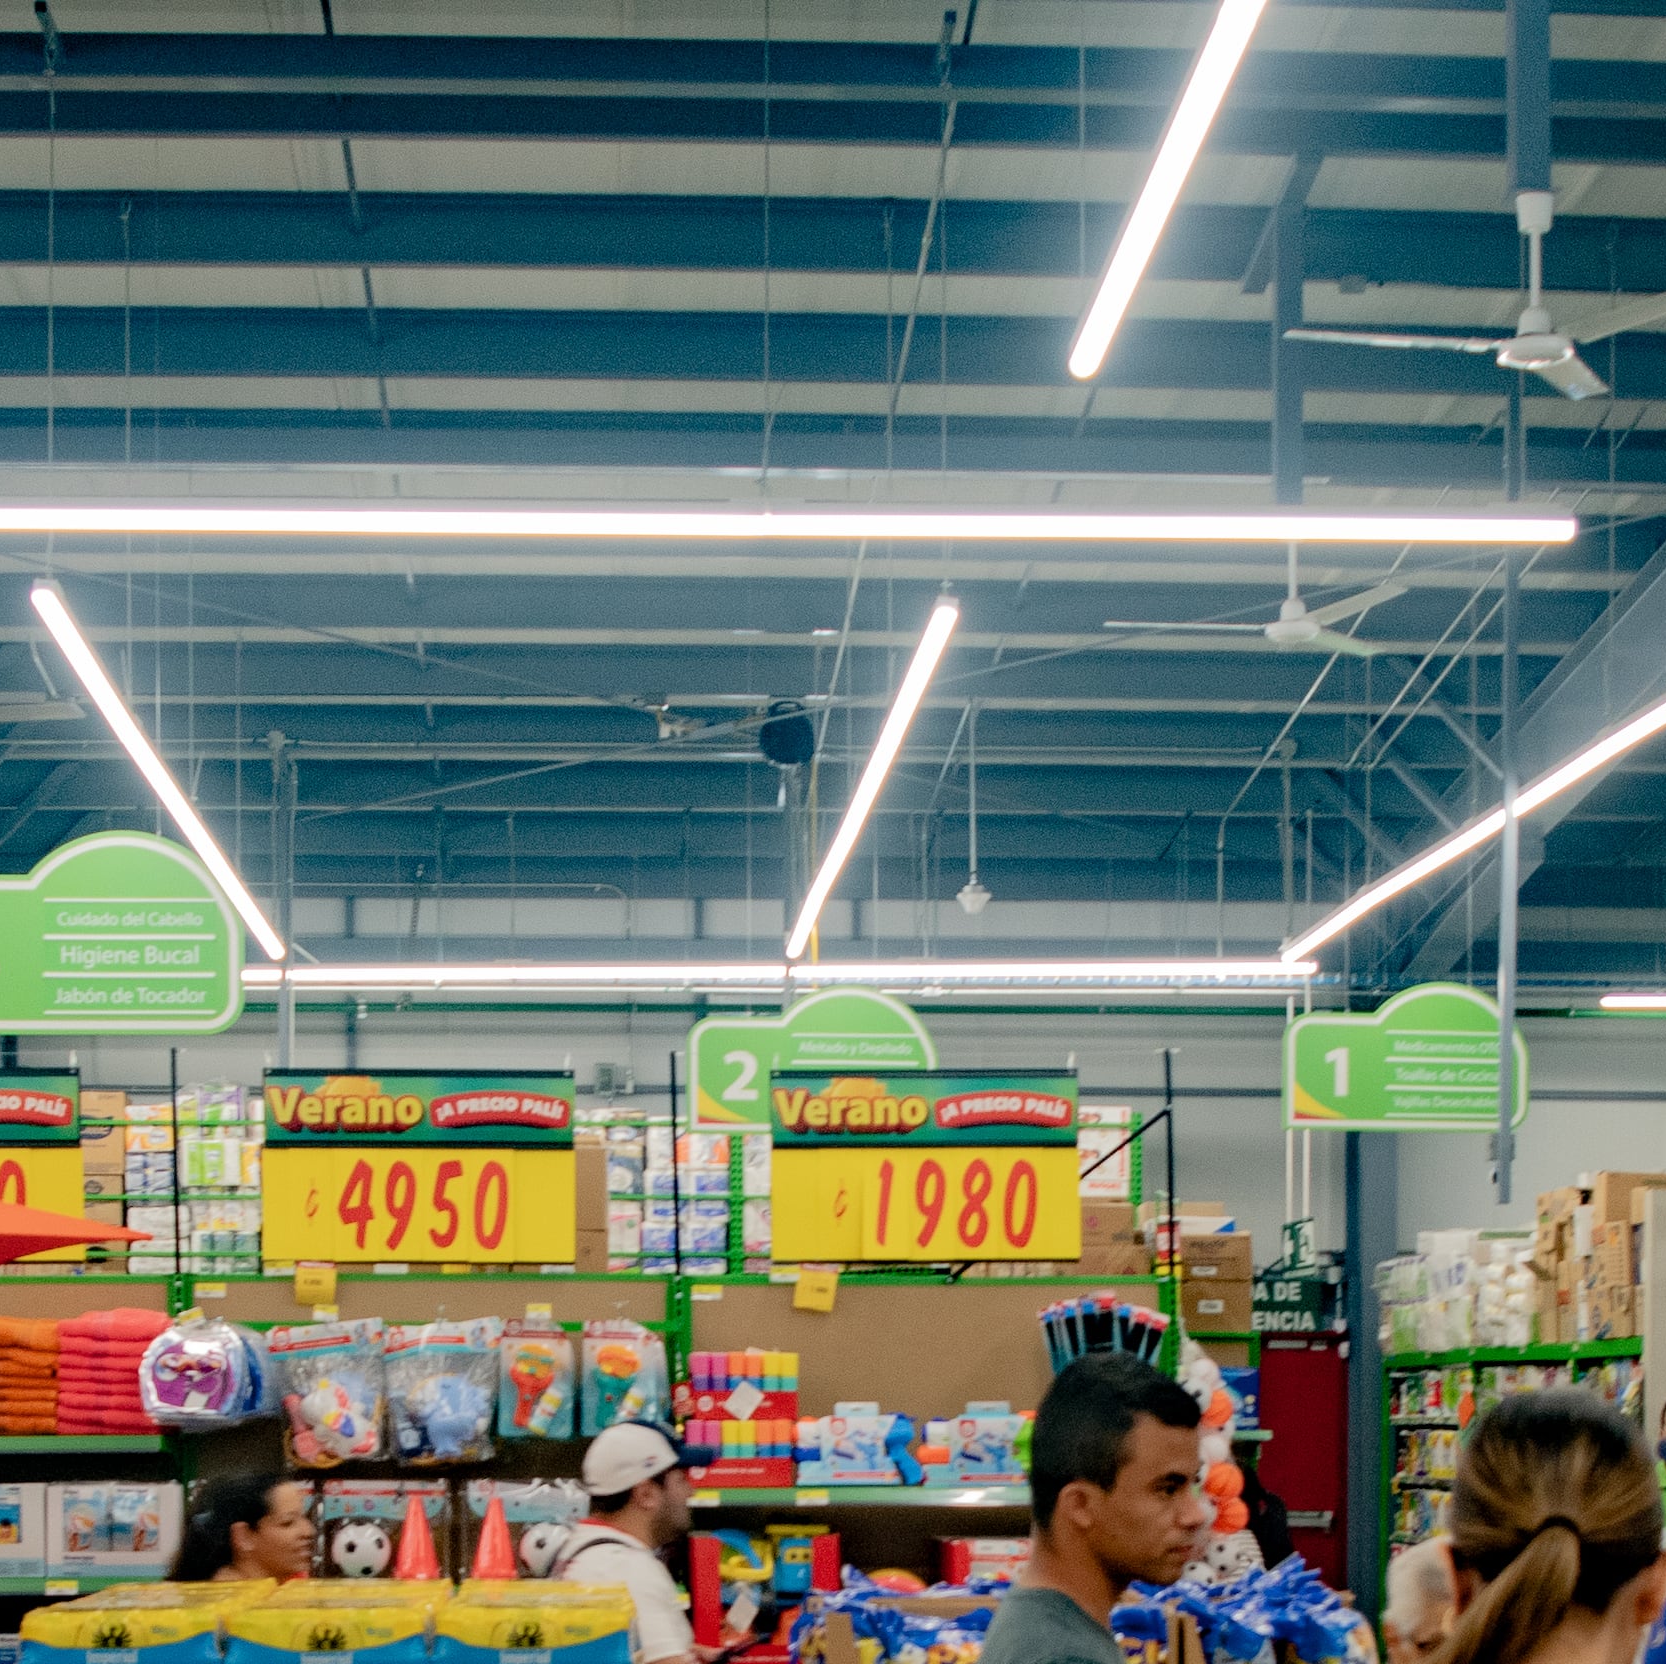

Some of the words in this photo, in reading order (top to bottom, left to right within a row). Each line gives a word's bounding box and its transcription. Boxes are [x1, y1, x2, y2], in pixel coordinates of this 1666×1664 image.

[56, 911, 117, 927] Cuidado
[121, 911, 144, 927] del
[147, 911, 203, 927] Cabello
[60, 944, 137, 971] Higiene
[144, 944, 199, 965] Bucal
[54, 983, 107, 1006] Jabón
[110, 986, 131, 1004] de
[136, 986, 206, 1005] Tocador
[722, 1050, 759, 1102] 2
[1324, 1047, 1350, 1098] 1
[265, 1086, 423, 1130] Verano
[456, 1097, 519, 1114] PRECIO
[772, 1086, 928, 1131] Verano
[958, 1096, 1021, 1113] PRECIO
[338, 1158, 509, 1251] 4950
[876, 1158, 1036, 1248] 1980
[1273, 1281, 1302, 1302] DE
[1251, 1310, 1317, 1332] ENCIA
